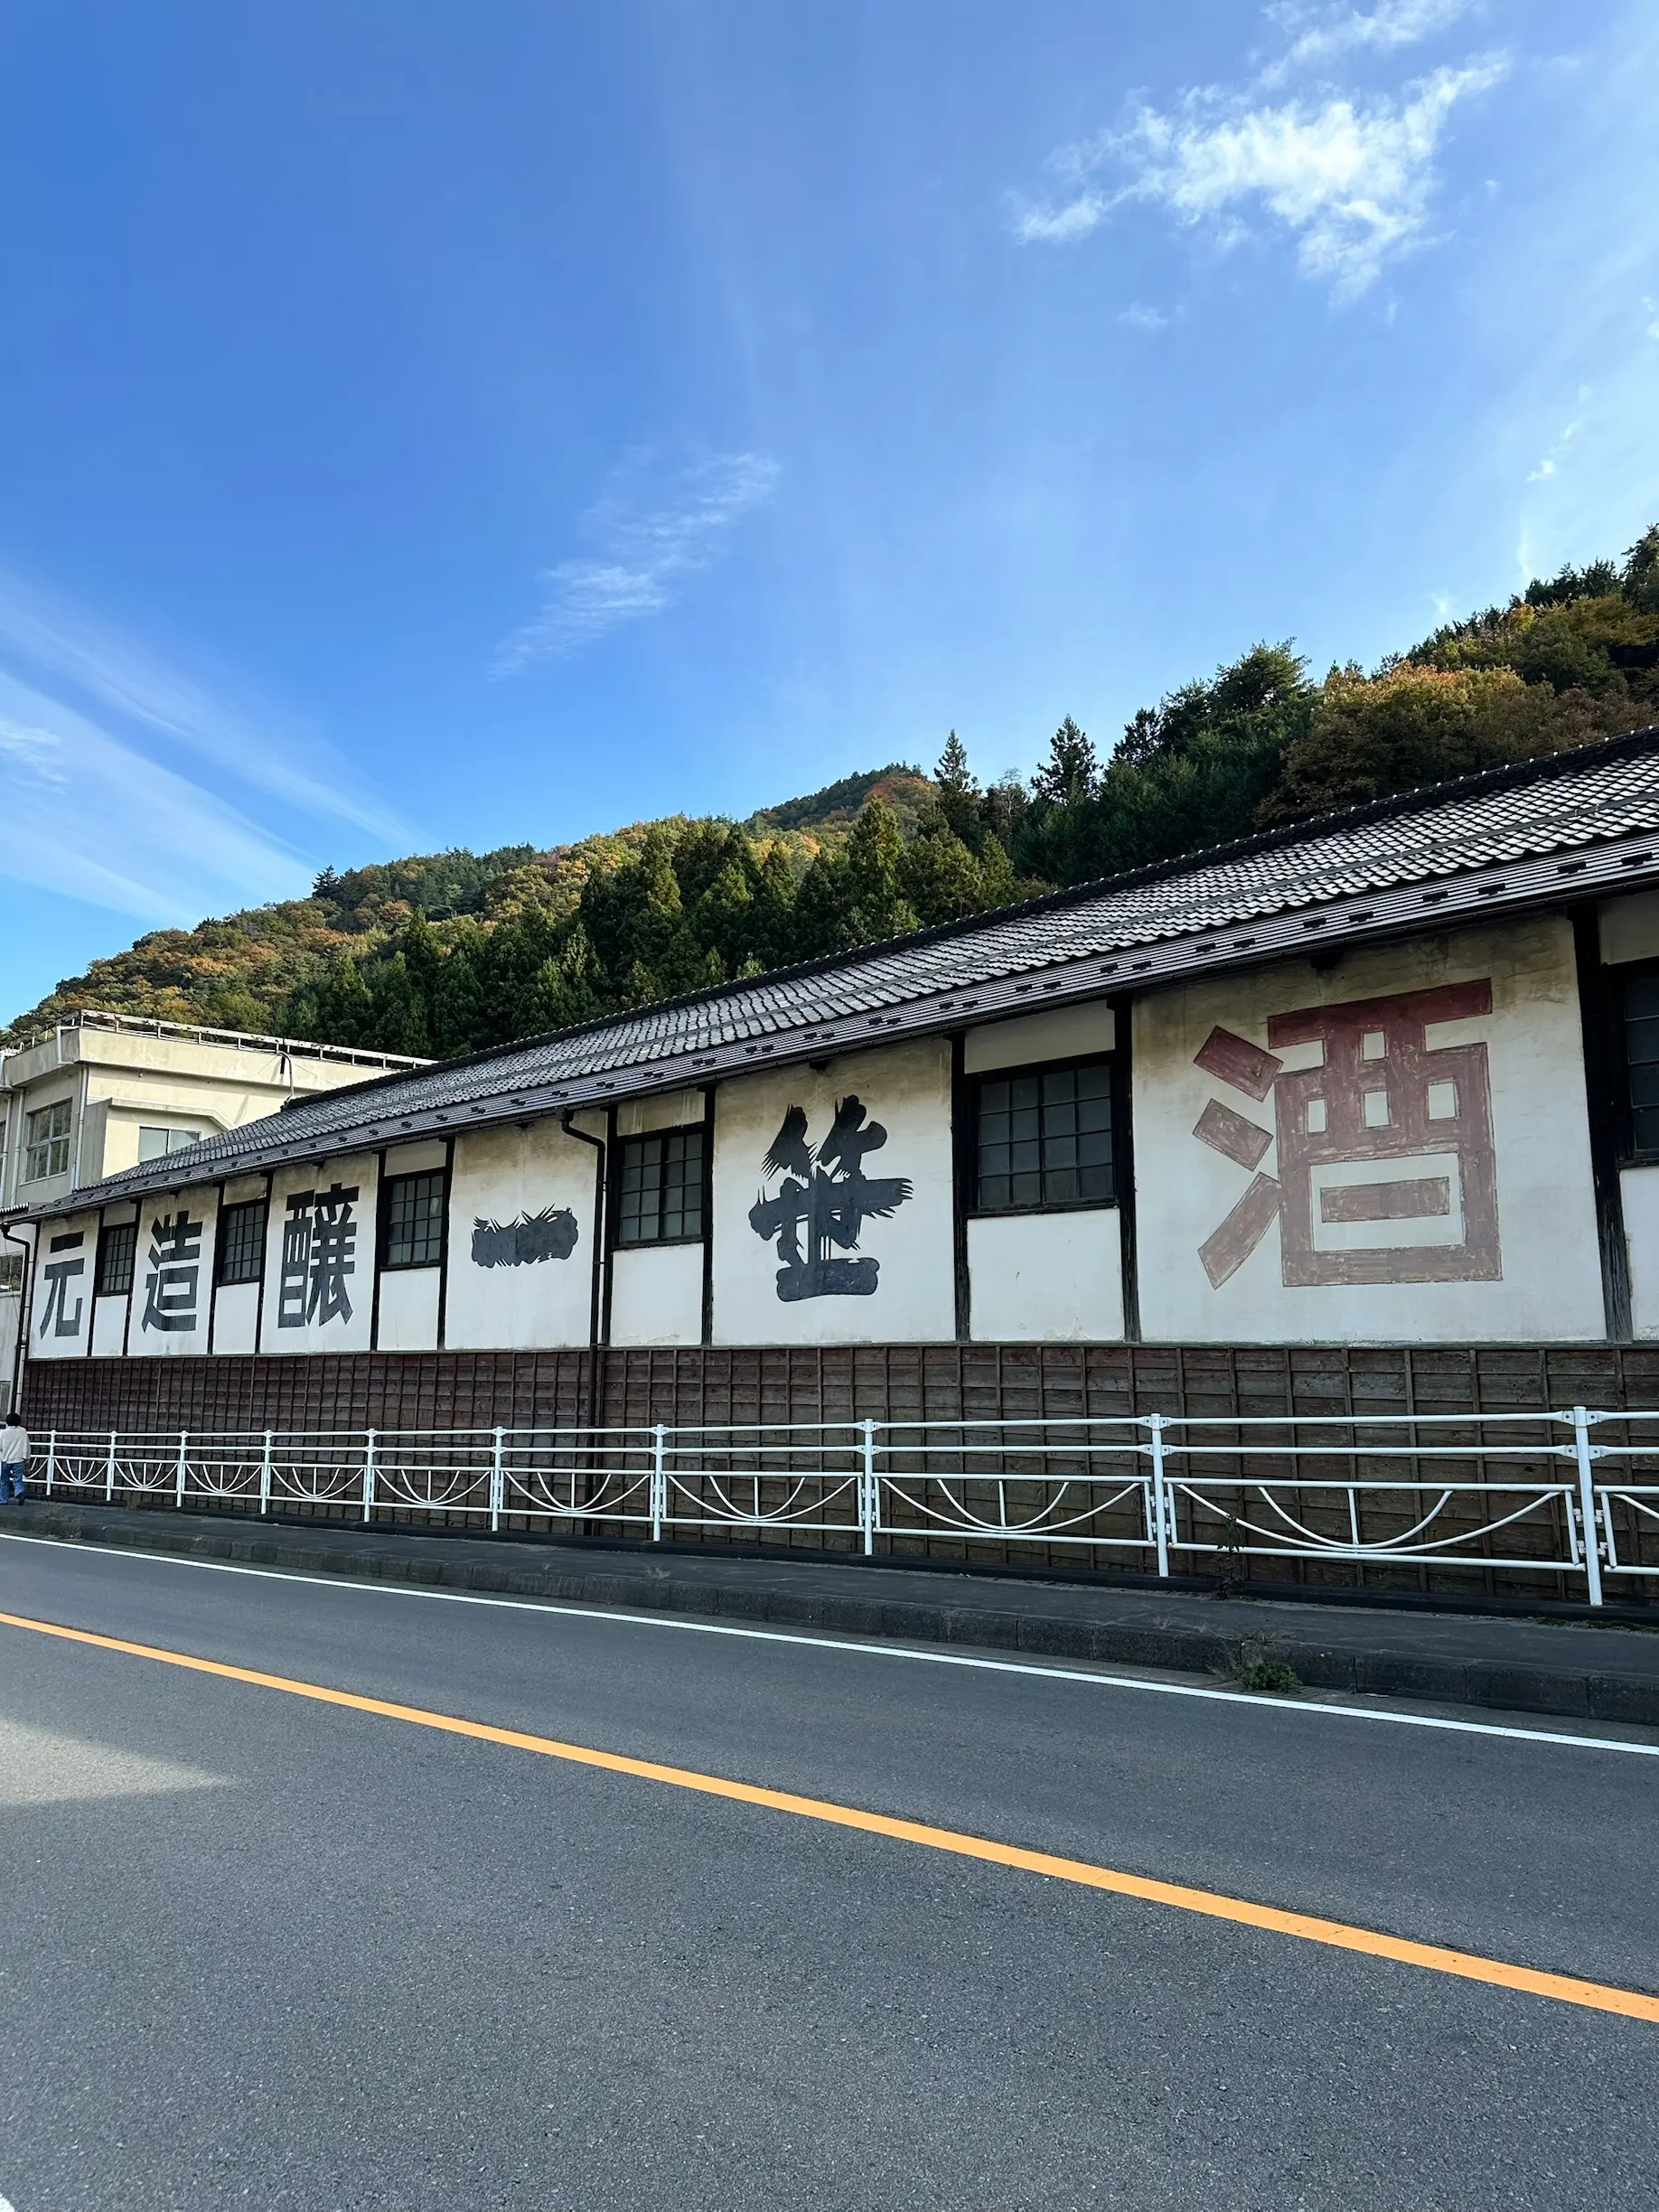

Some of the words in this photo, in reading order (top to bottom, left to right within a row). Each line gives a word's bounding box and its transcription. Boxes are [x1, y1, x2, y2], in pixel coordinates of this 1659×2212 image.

[1193, 979, 1504, 1290] 酒
[39, 1231, 84, 1339] 元
[142, 1210, 202, 1333] 造
